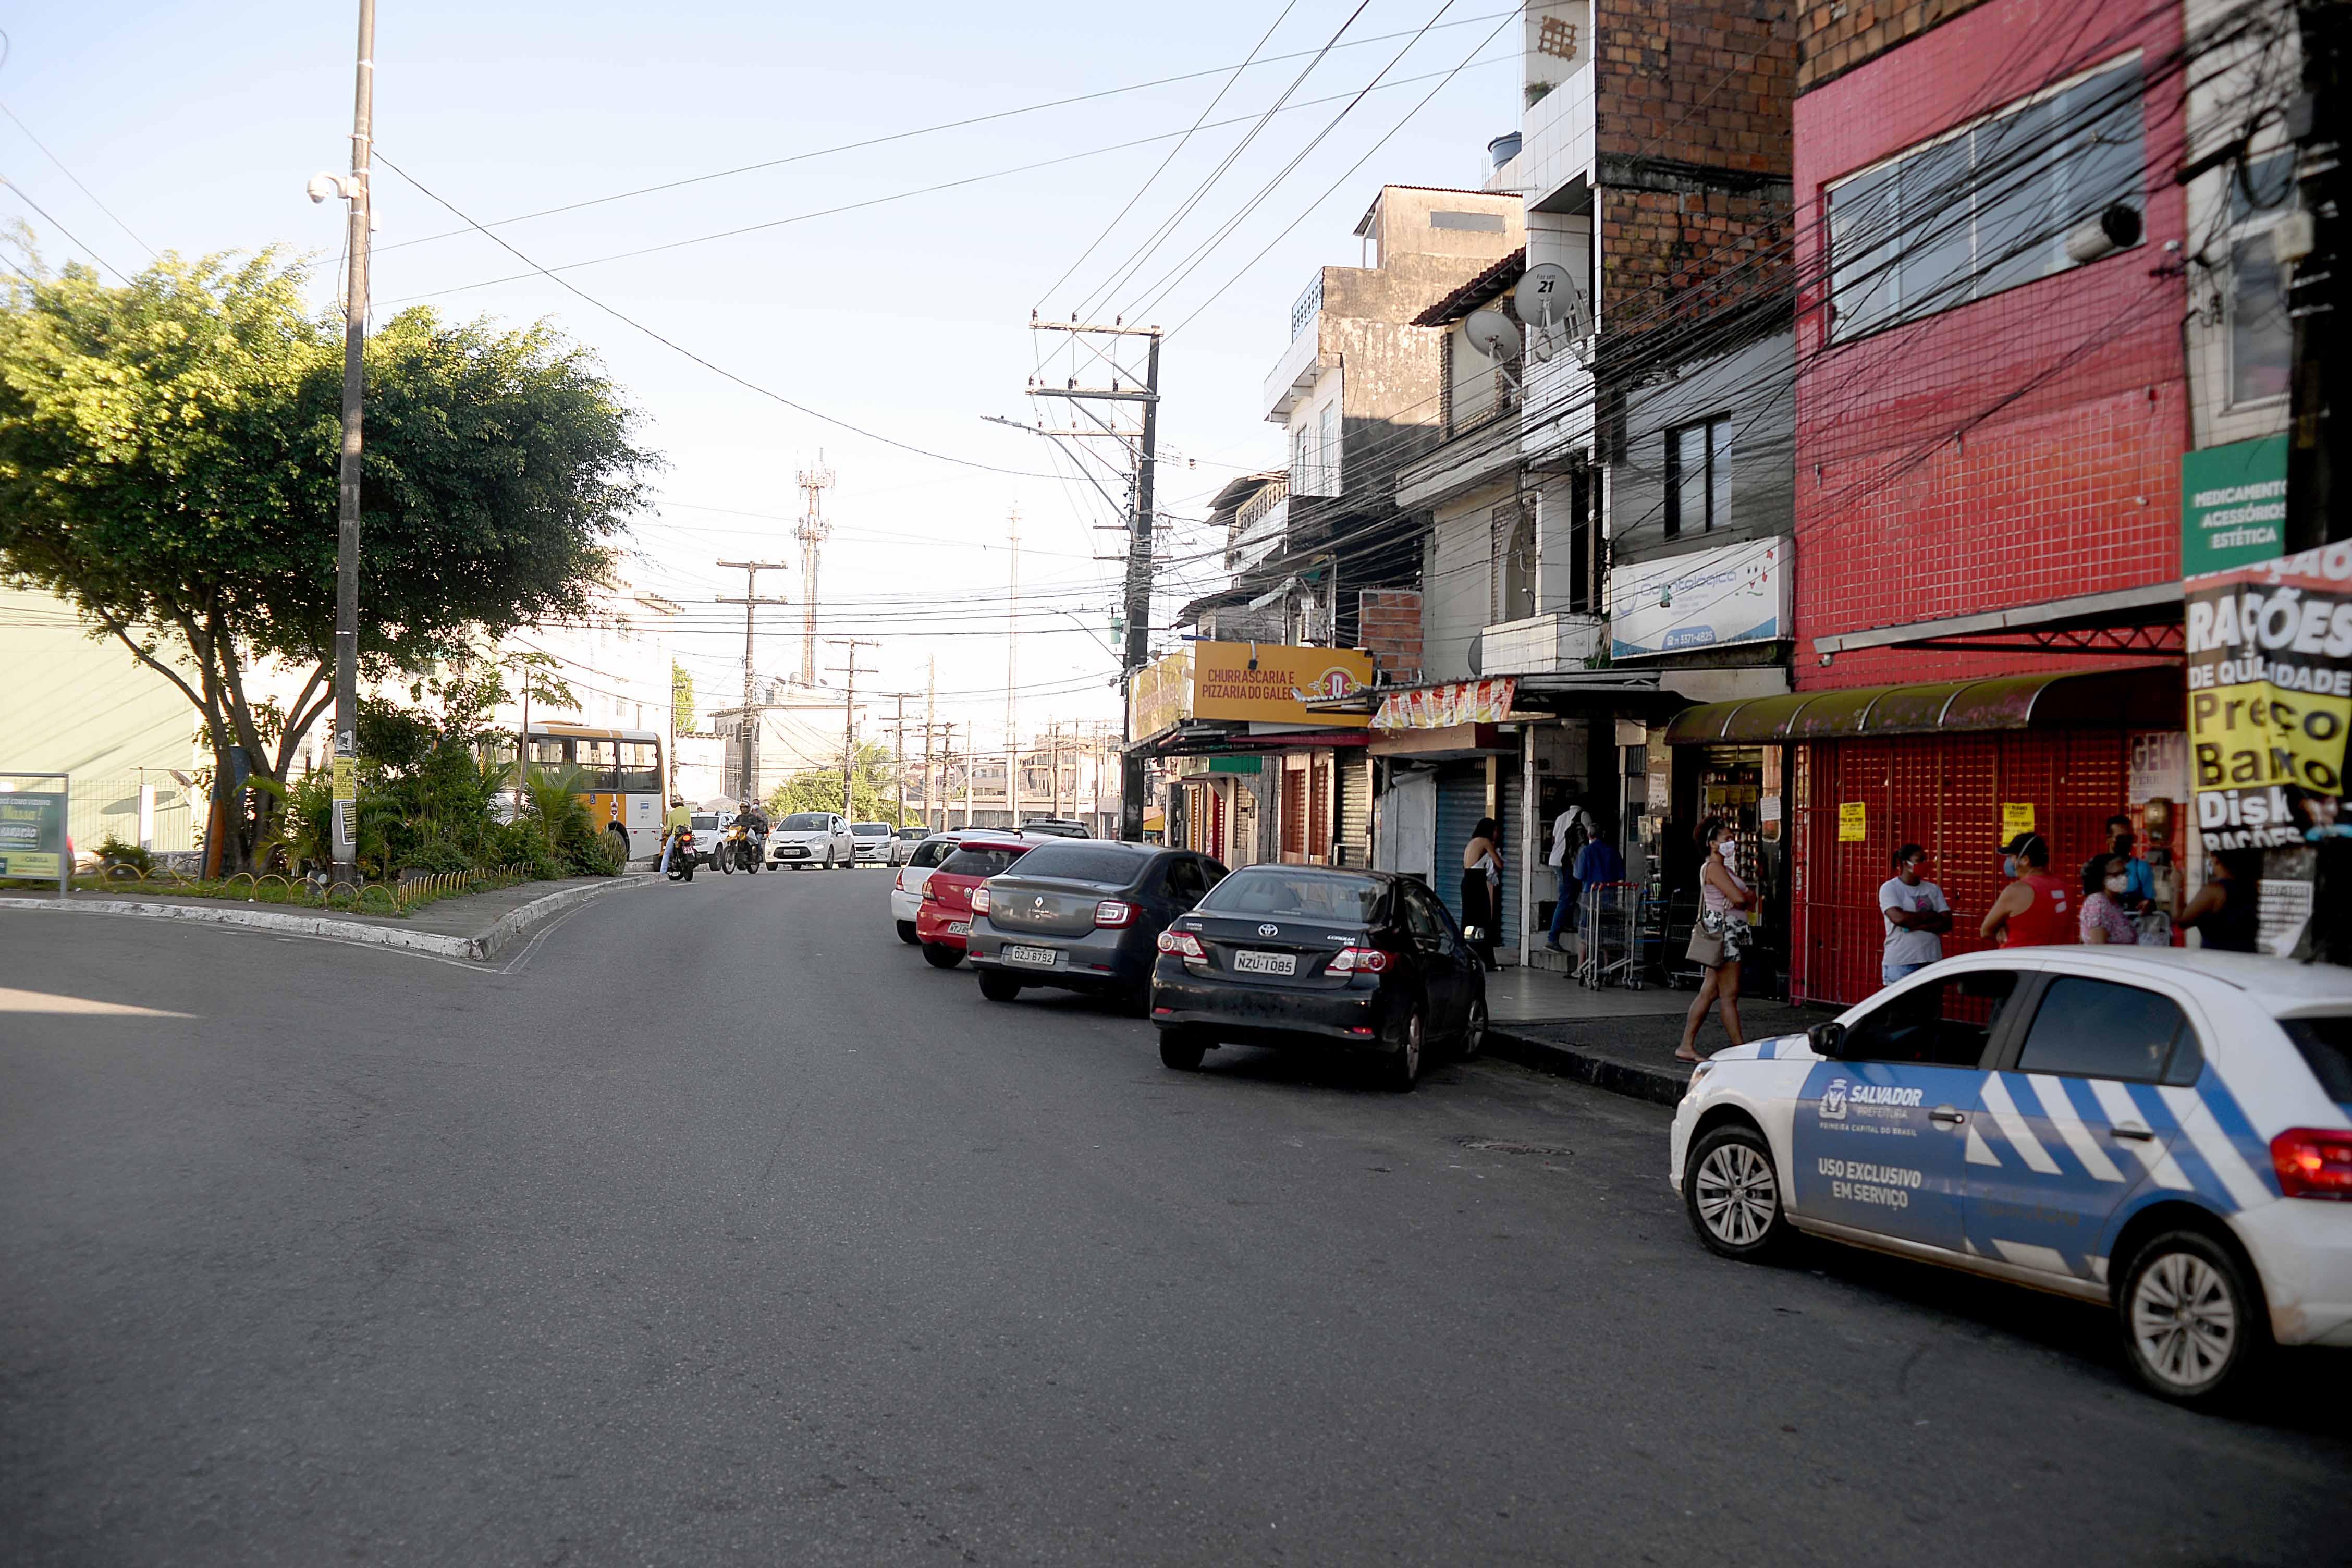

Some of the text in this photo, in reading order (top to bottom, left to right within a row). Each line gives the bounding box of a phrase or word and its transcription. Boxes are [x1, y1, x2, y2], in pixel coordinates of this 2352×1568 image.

[1537, 280, 1554, 293] 21
[2212, 525, 2277, 550] ESTÉTICA
[1208, 669, 1295, 684] CHURRASCARIA E
[2190, 655, 2352, 696] DE QULIDADE
[1202, 684, 1301, 700] PIZZARIA DO GALEG
[2198, 786, 2294, 828] Disk
[1238, 957, 1292, 972] NZU-1085
[1849, 1085, 1923, 1107] SALVADOR
[1857, 1106, 1908, 1120] PREFEITURA
[1819, 1121, 1849, 1131] PRIMEIRA
[1851, 1124, 1879, 1135] CAPITAL
[1893, 1127, 1918, 1137] BRASIL
[1818, 1157, 1922, 1189] USO EXCLUSIVO
[1832, 1180, 1909, 1212] EM SERVIÇO
